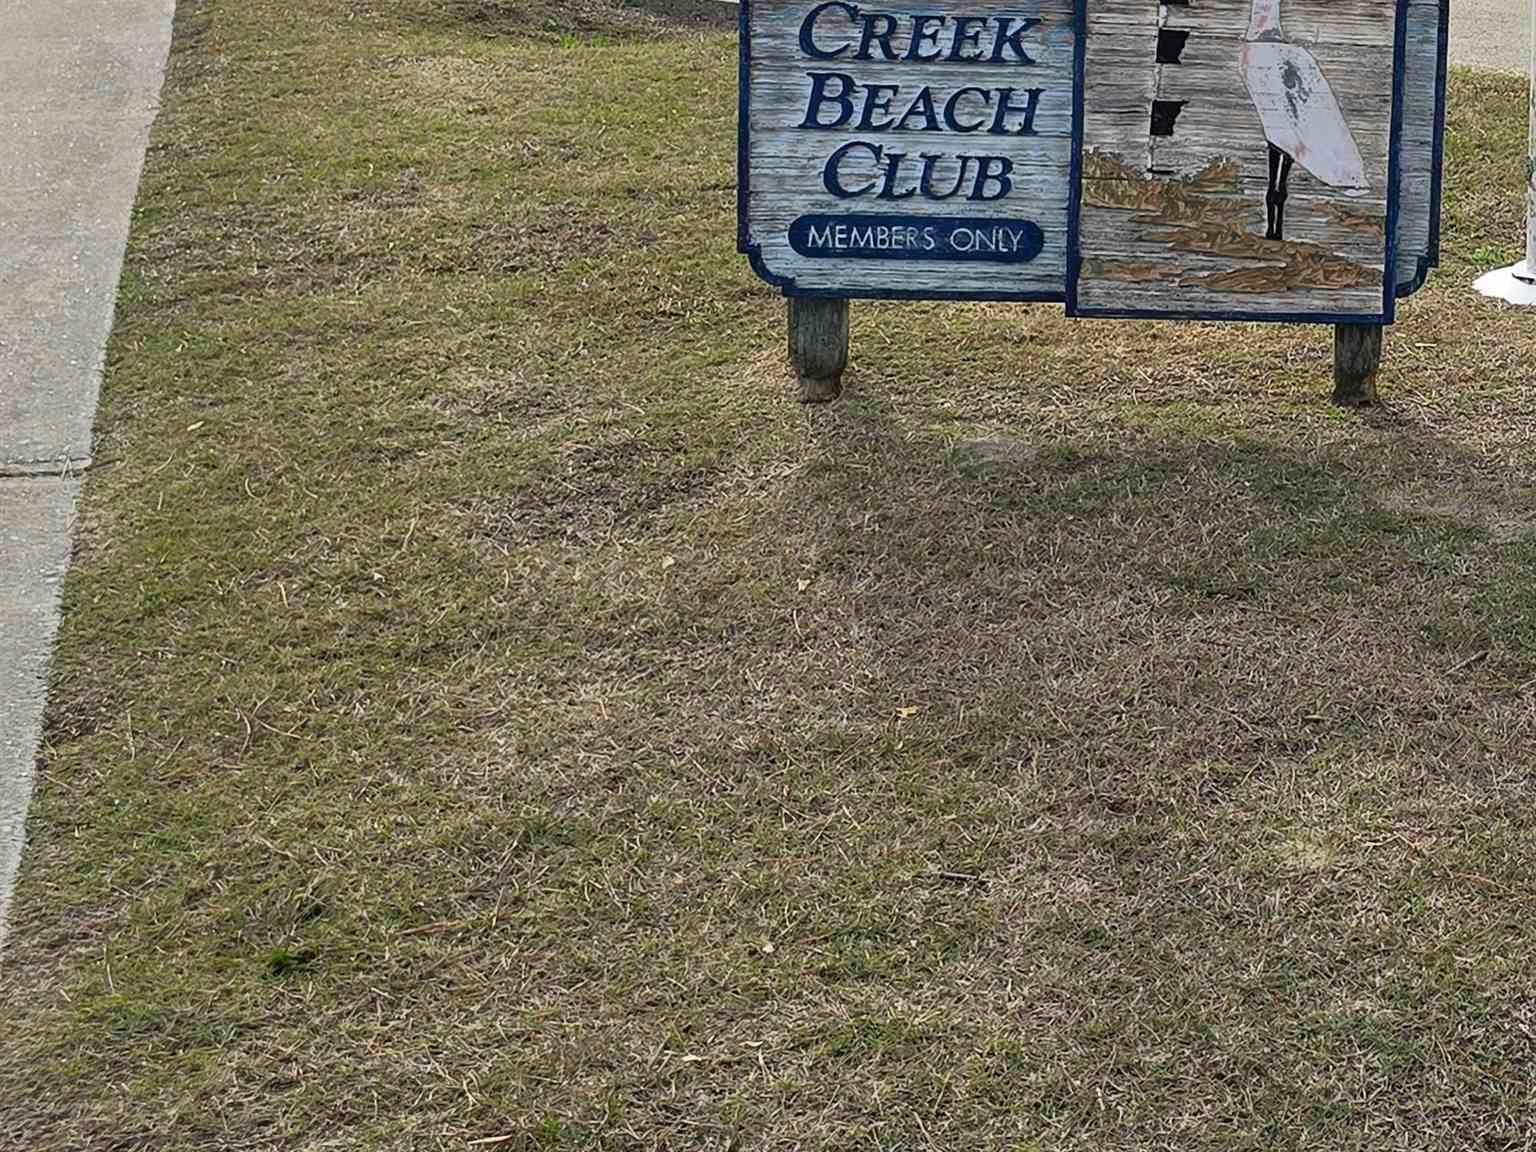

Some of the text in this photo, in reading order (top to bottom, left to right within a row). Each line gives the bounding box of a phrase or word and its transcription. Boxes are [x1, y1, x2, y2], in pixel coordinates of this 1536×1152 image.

[798, 1, 1043, 64] CREEK
[796, 72, 1046, 135] BEACH
[822, 140, 1014, 201] CLUB
[808, 224, 1024, 252] MEMBERS ONLY
